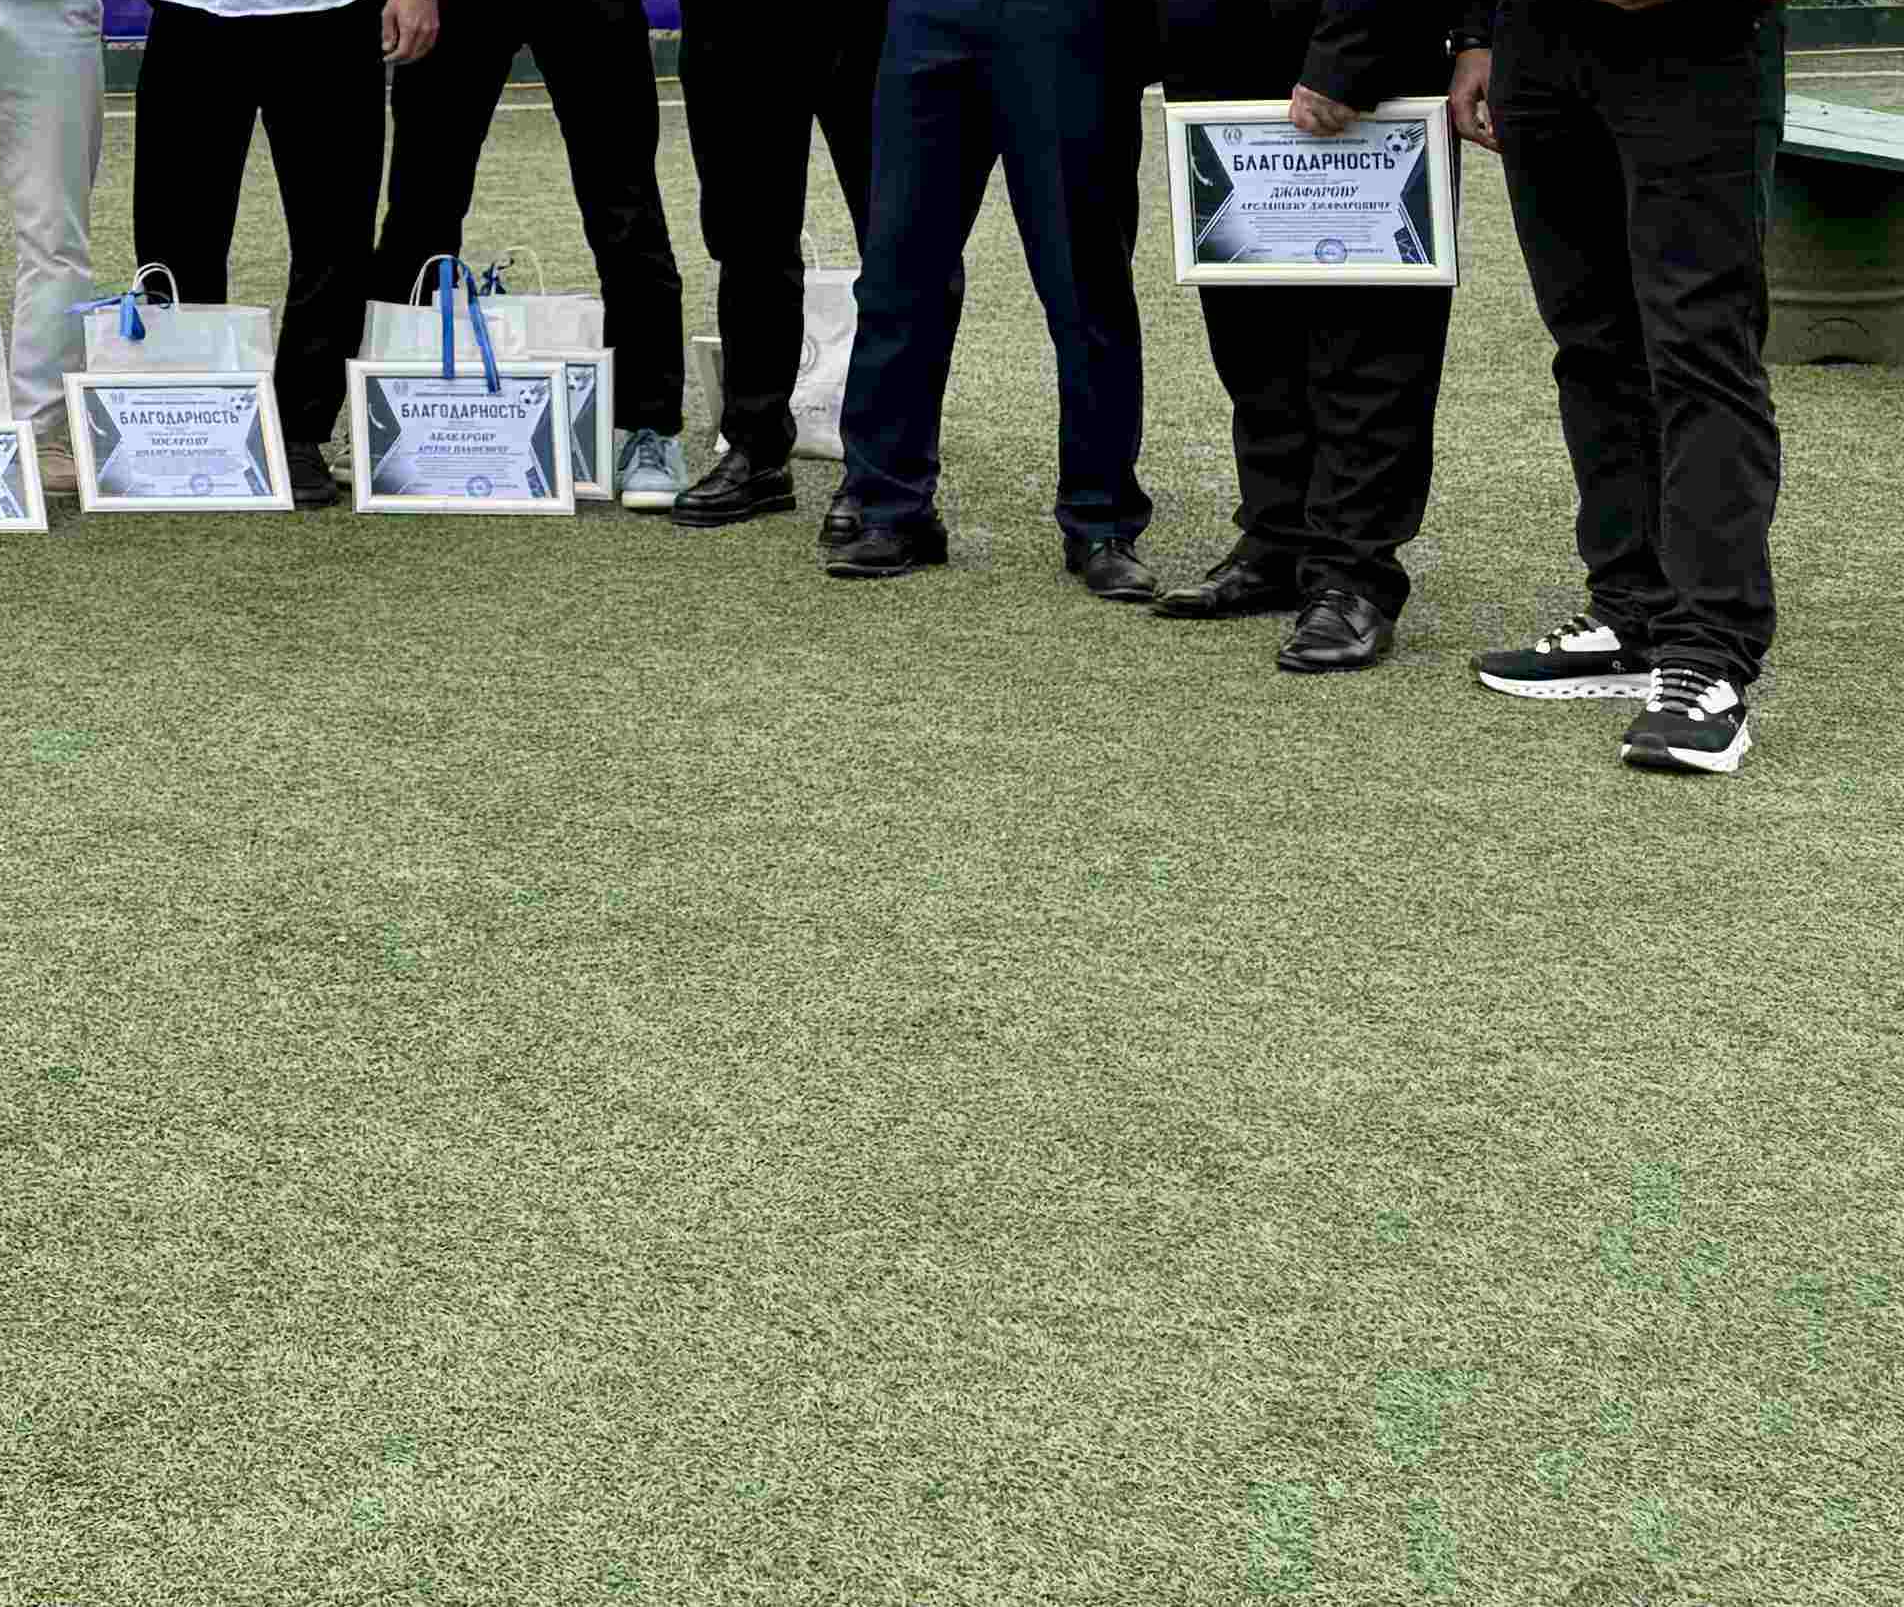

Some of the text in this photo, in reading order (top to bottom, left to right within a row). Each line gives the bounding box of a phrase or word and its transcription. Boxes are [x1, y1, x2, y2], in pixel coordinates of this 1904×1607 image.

[1233, 151, 1396, 173] БЛАГОДАРНОСТЬ
[119, 409, 240, 426] БЛАГОДАРНОСТЬ
[400, 402, 528, 420] БЛАГОДАРНОСТЬ
